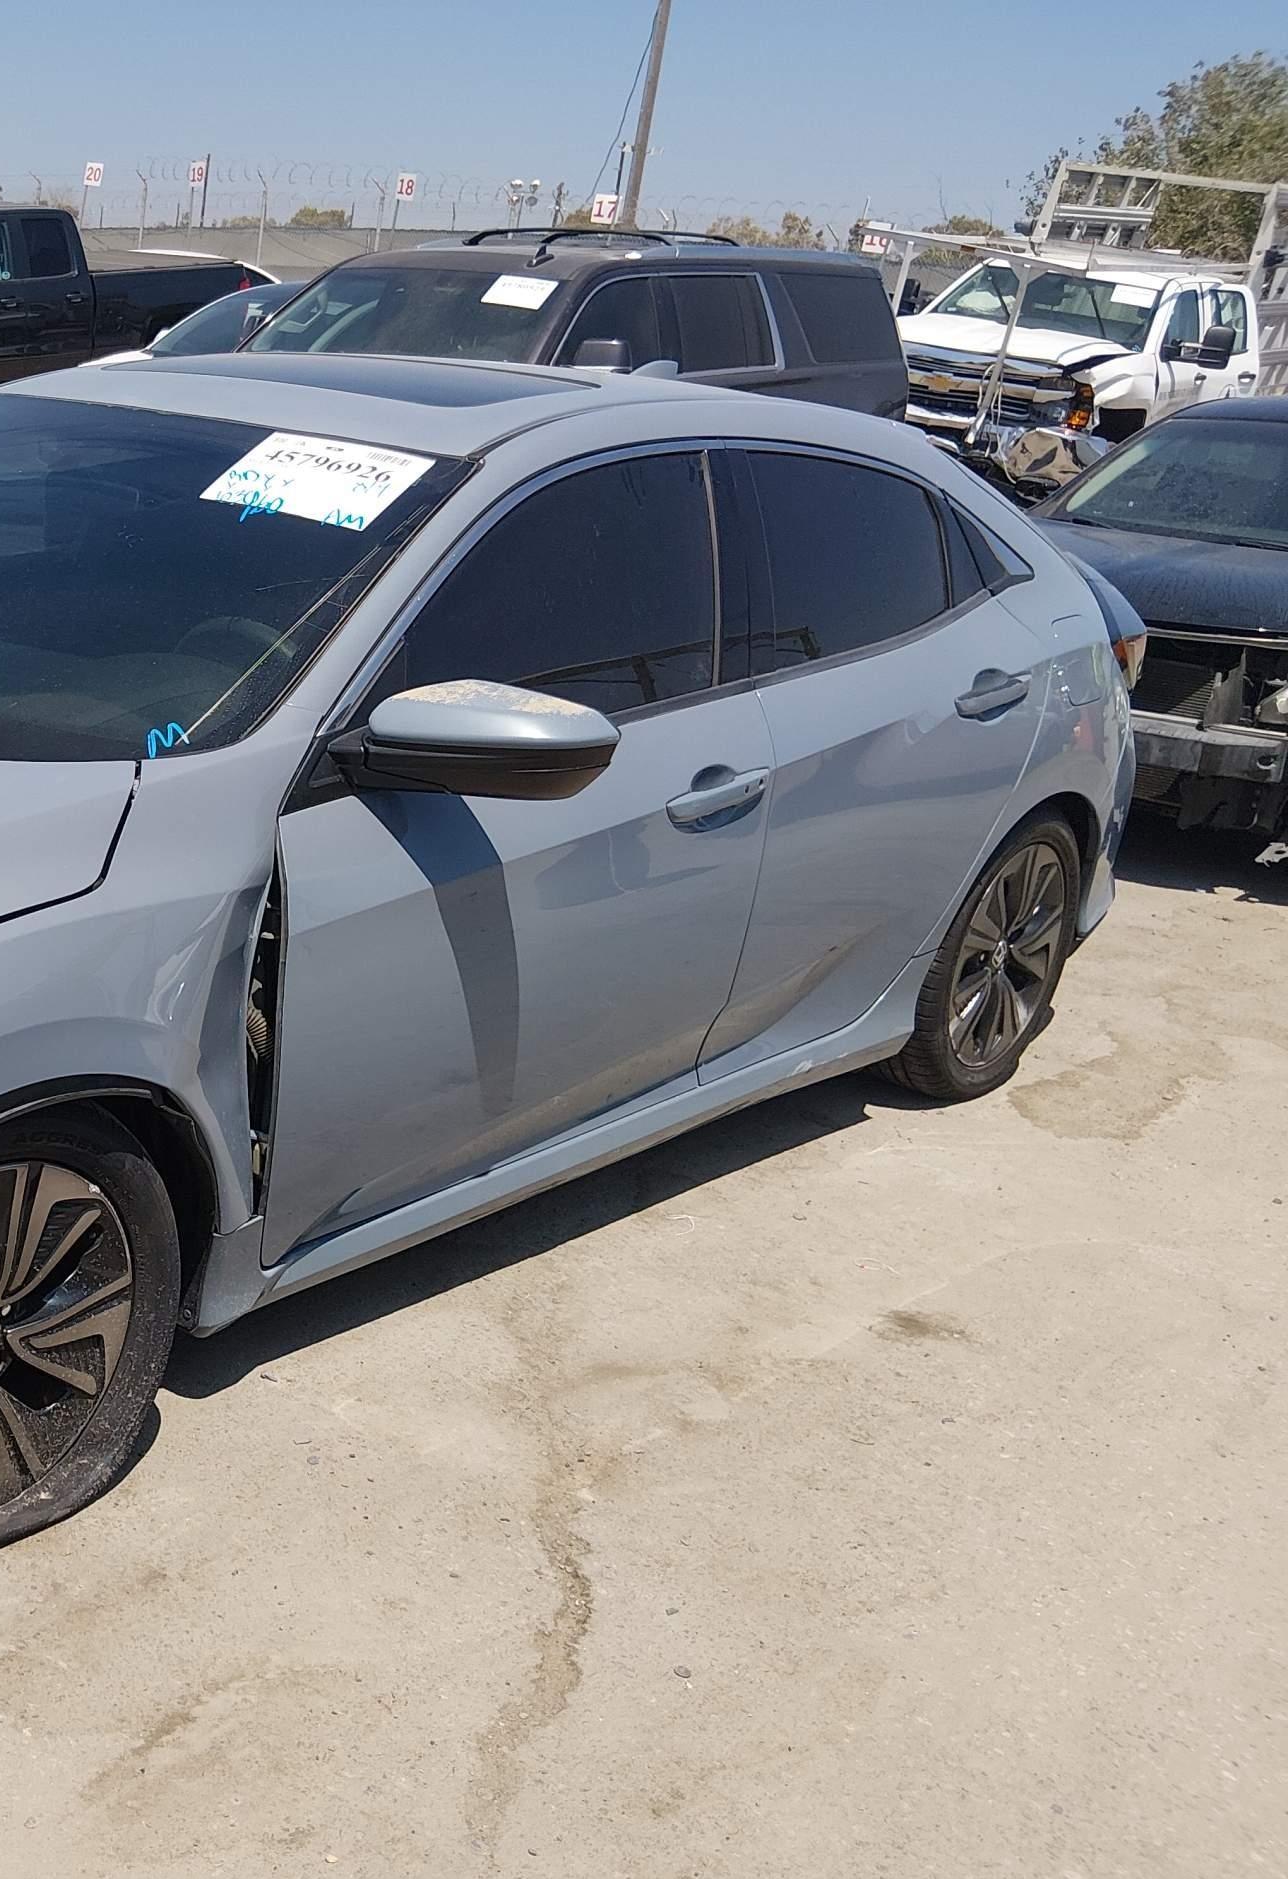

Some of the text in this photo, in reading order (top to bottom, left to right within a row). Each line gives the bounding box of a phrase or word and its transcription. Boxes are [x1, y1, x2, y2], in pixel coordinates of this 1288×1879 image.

[86, 166, 102, 182] 20
[192, 166, 204, 182] 19
[397, 178, 415, 196] 18
[592, 201, 619, 218] 17
[264, 449, 394, 483] 45796926
